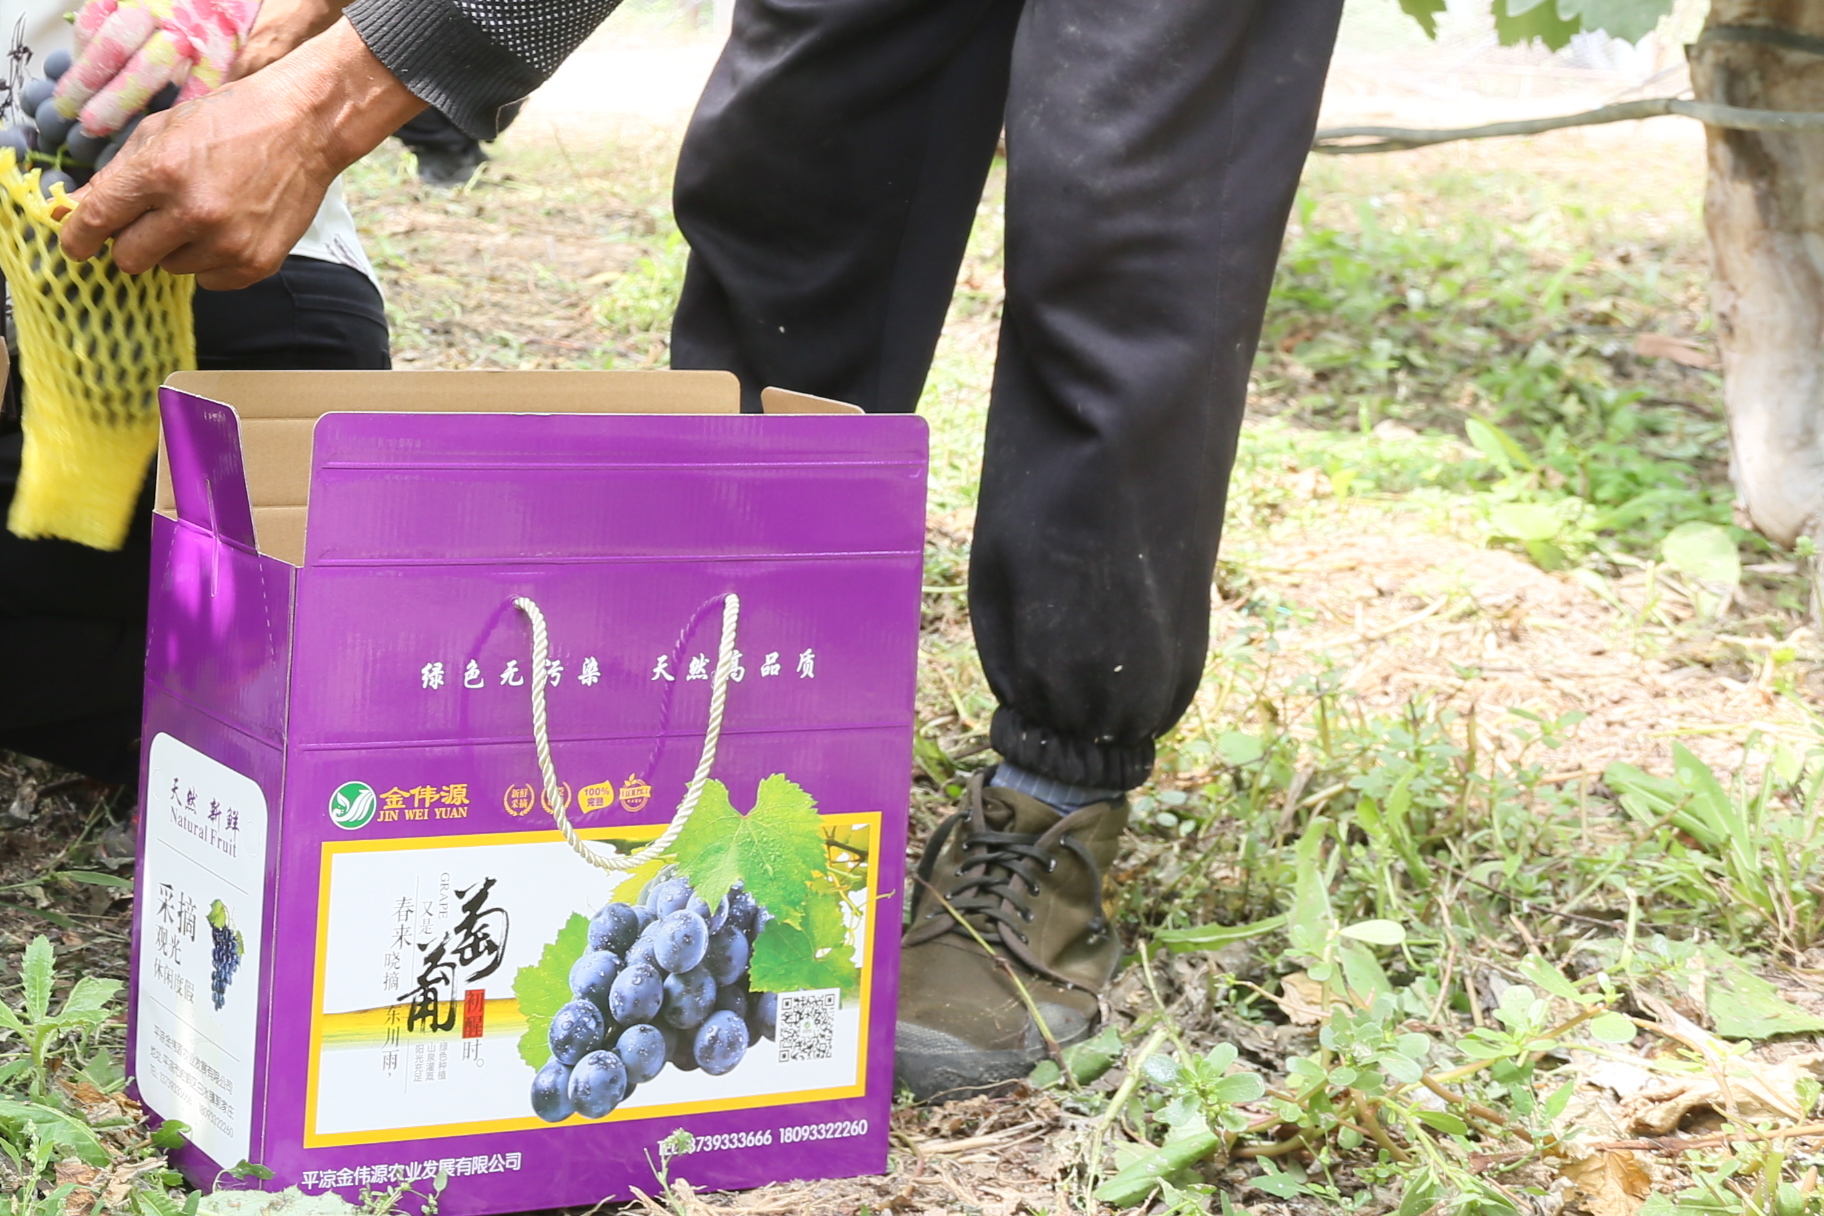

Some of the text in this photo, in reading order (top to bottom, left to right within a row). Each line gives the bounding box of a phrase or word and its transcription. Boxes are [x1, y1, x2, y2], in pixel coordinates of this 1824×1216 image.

[420, 648, 816, 690] 绿色无污染 天然高品质
[170, 777, 198, 815] 天然
[379, 784, 470, 809] 金伟源
[584, 787, 610, 797] 100%
[169, 805, 238, 858] Natural Fruit
[377, 807, 468, 822] JIN WEI YUAN
[156, 882, 197, 942] 采摘
[438, 872, 450, 919] GRAPE
[419, 900, 434, 935] 又是
[154, 924, 182, 966] 观光
[153, 957, 195, 1004] 休闲度假
[779, 1119, 869, 1143] 18093322260
[301, 1152, 522, 1190] 平凉金伟源农业发展有限公司
